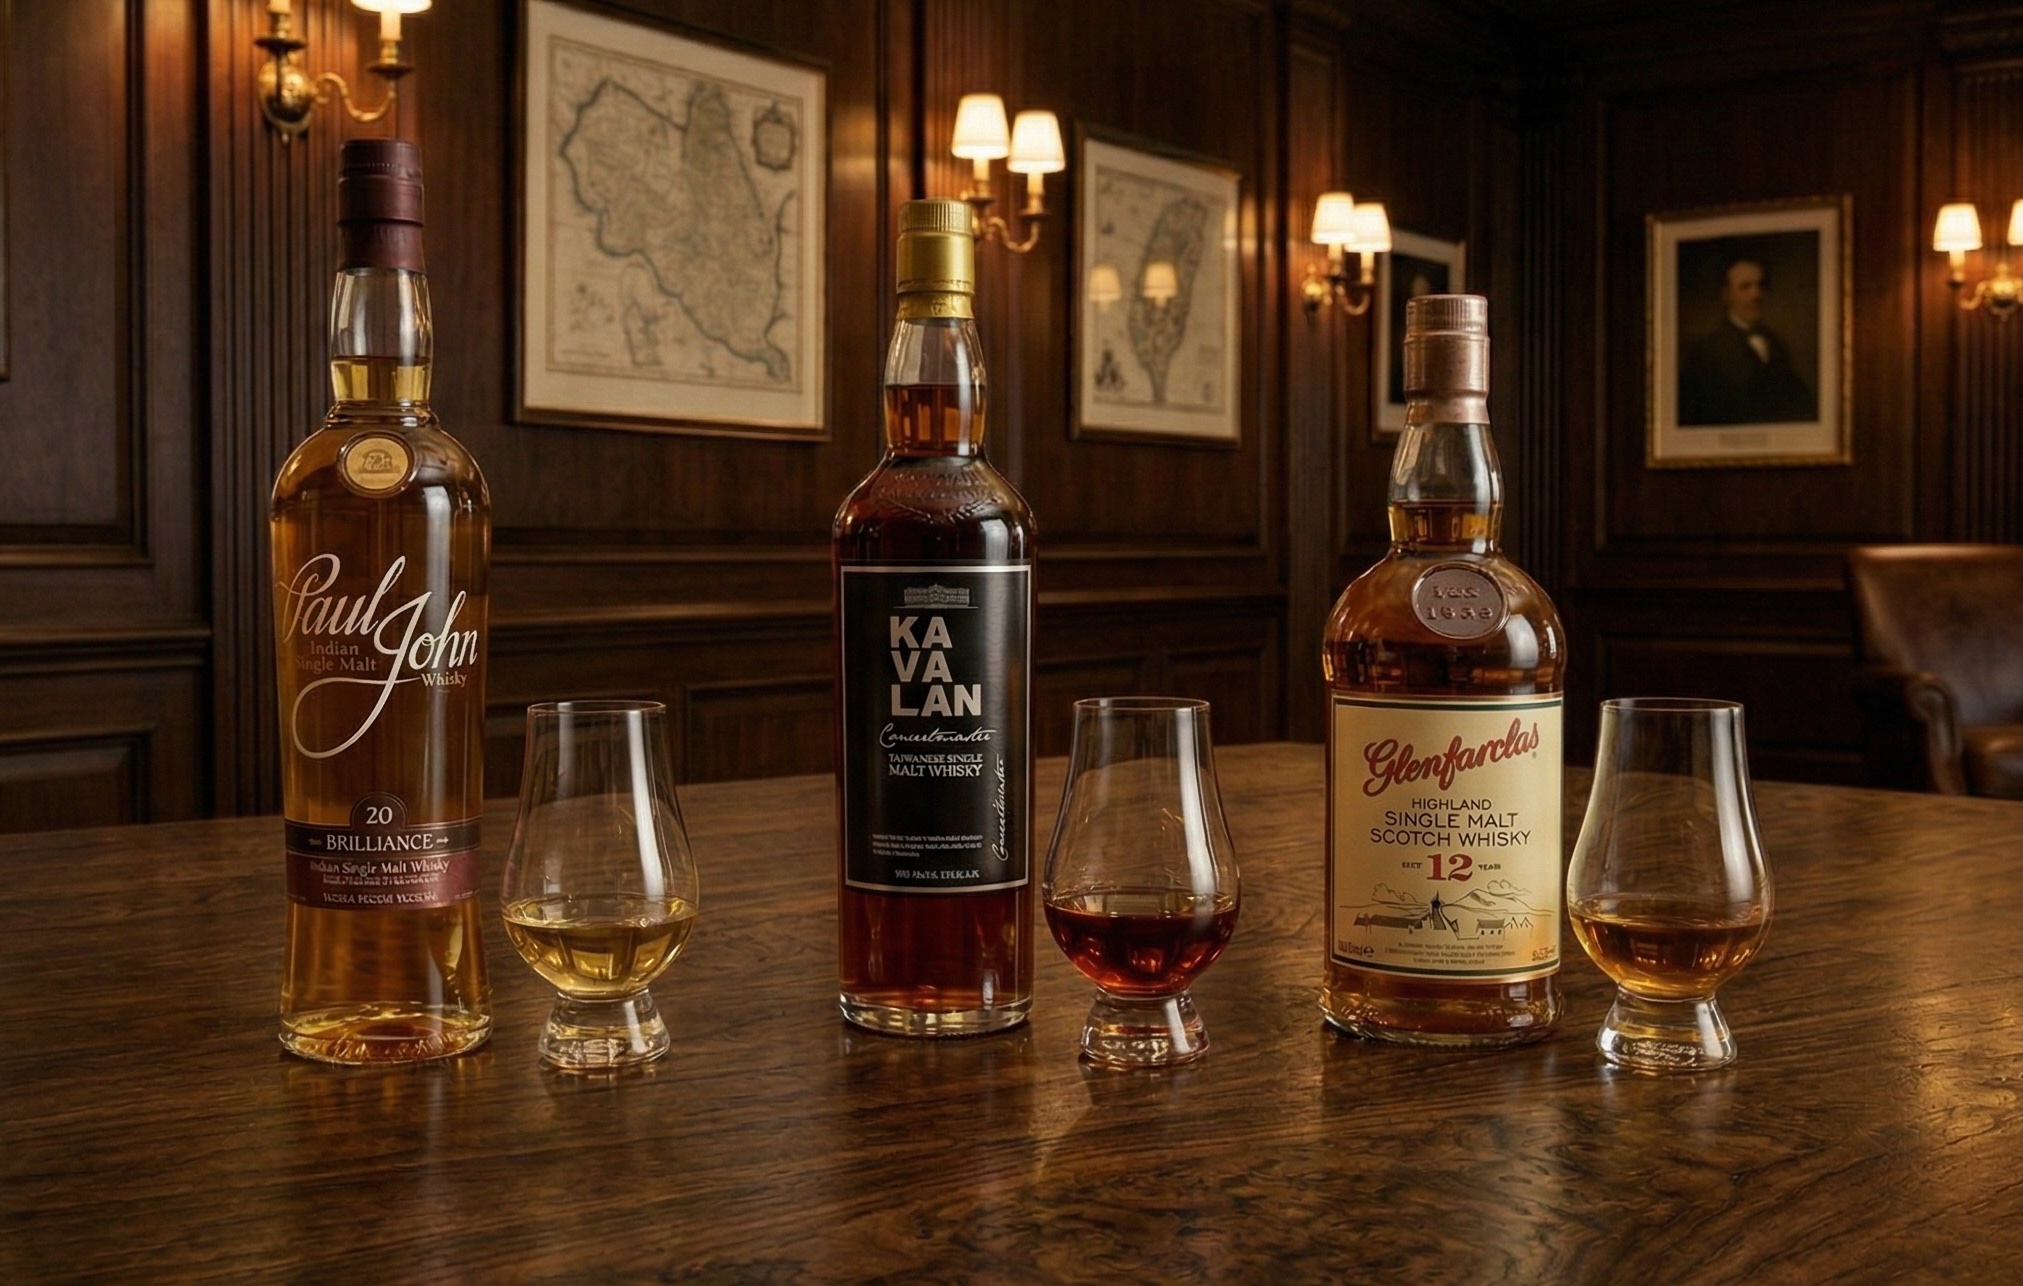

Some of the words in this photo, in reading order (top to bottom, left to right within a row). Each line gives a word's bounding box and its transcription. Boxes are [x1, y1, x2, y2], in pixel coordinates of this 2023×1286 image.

[276, 553, 406, 643] Paul
[890, 616, 953, 648] KA
[310, 640, 359, 655] Indian
[339, 656, 377, 671] Malt
[891, 651, 953, 682] VA
[420, 671, 468, 687] Whisky
[891, 684, 982, 716] LAN
[1362, 717, 1539, 797] Glenfarclas
[889, 764, 926, 777] MALT
[928, 764, 983, 777] WHISKY
[1411, 798, 1493, 811] HIGHLAND
[366, 806, 394, 825] 20
[1385, 811, 1461, 829] SINGLE
[1467, 812, 1519, 828] MALT
[326, 833, 434, 852] BRILLIANCE
[1370, 828, 1451, 847] SCOTCH
[1457, 830, 1532, 848] WHISKY
[1426, 853, 1474, 882] 12
